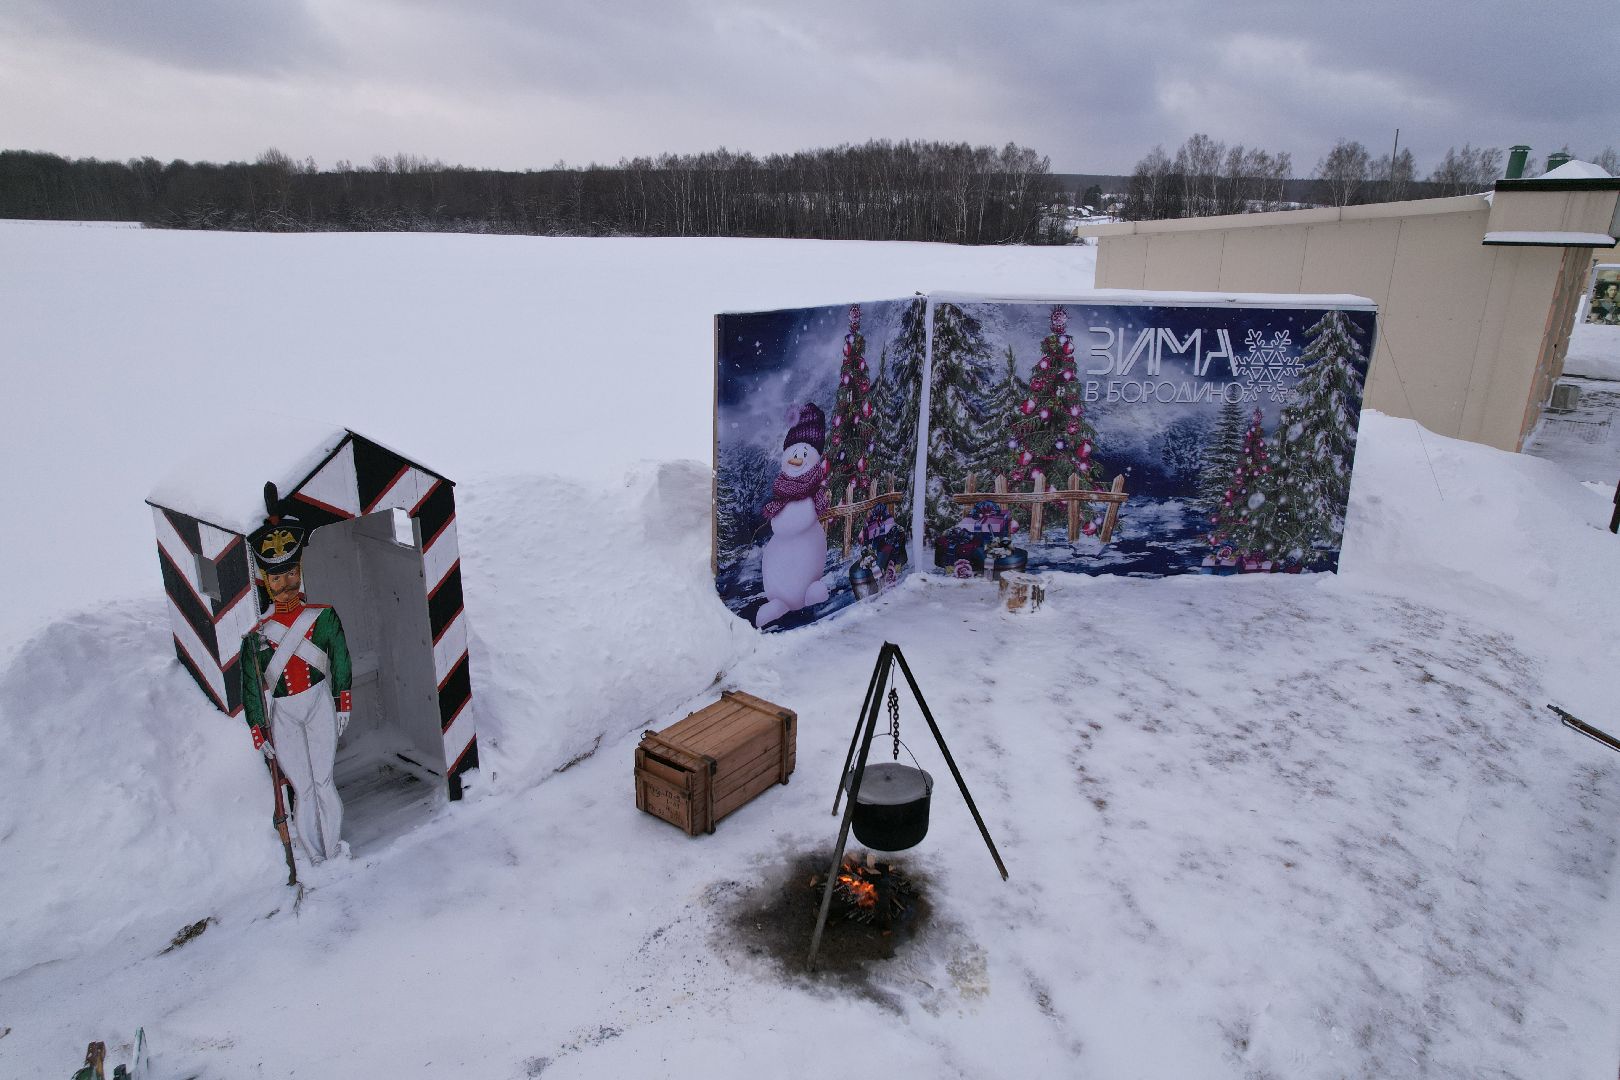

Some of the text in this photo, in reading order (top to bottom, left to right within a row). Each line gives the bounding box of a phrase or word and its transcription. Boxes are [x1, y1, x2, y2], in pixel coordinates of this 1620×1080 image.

[1086, 326, 1238, 376] ЗИМА
[1085, 381, 1245, 403] В БОРОДИНО
